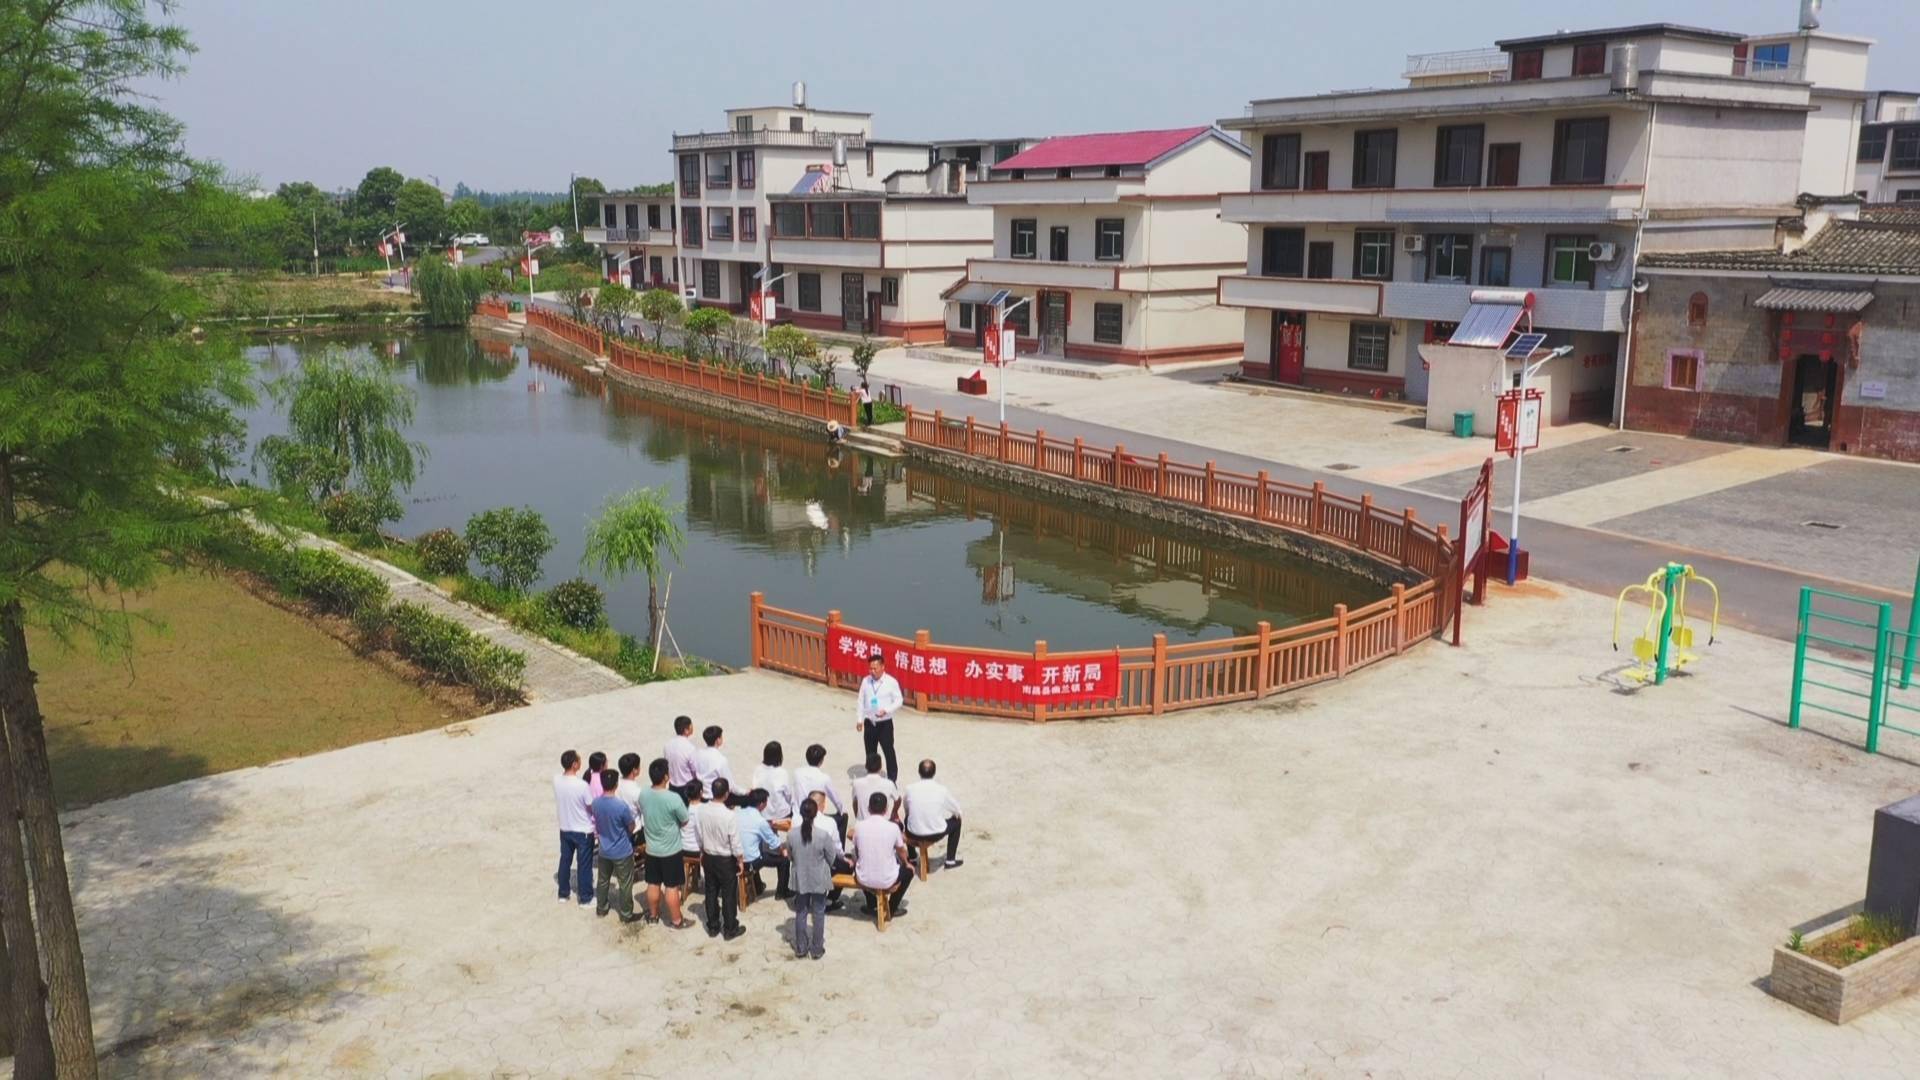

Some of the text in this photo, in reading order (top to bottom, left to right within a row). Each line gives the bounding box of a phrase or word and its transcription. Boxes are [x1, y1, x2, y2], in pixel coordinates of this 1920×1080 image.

[895, 649, 948, 676] 悟思想
[965, 660, 1025, 683] 办实事
[1042, 663, 1101, 684] 开新局
